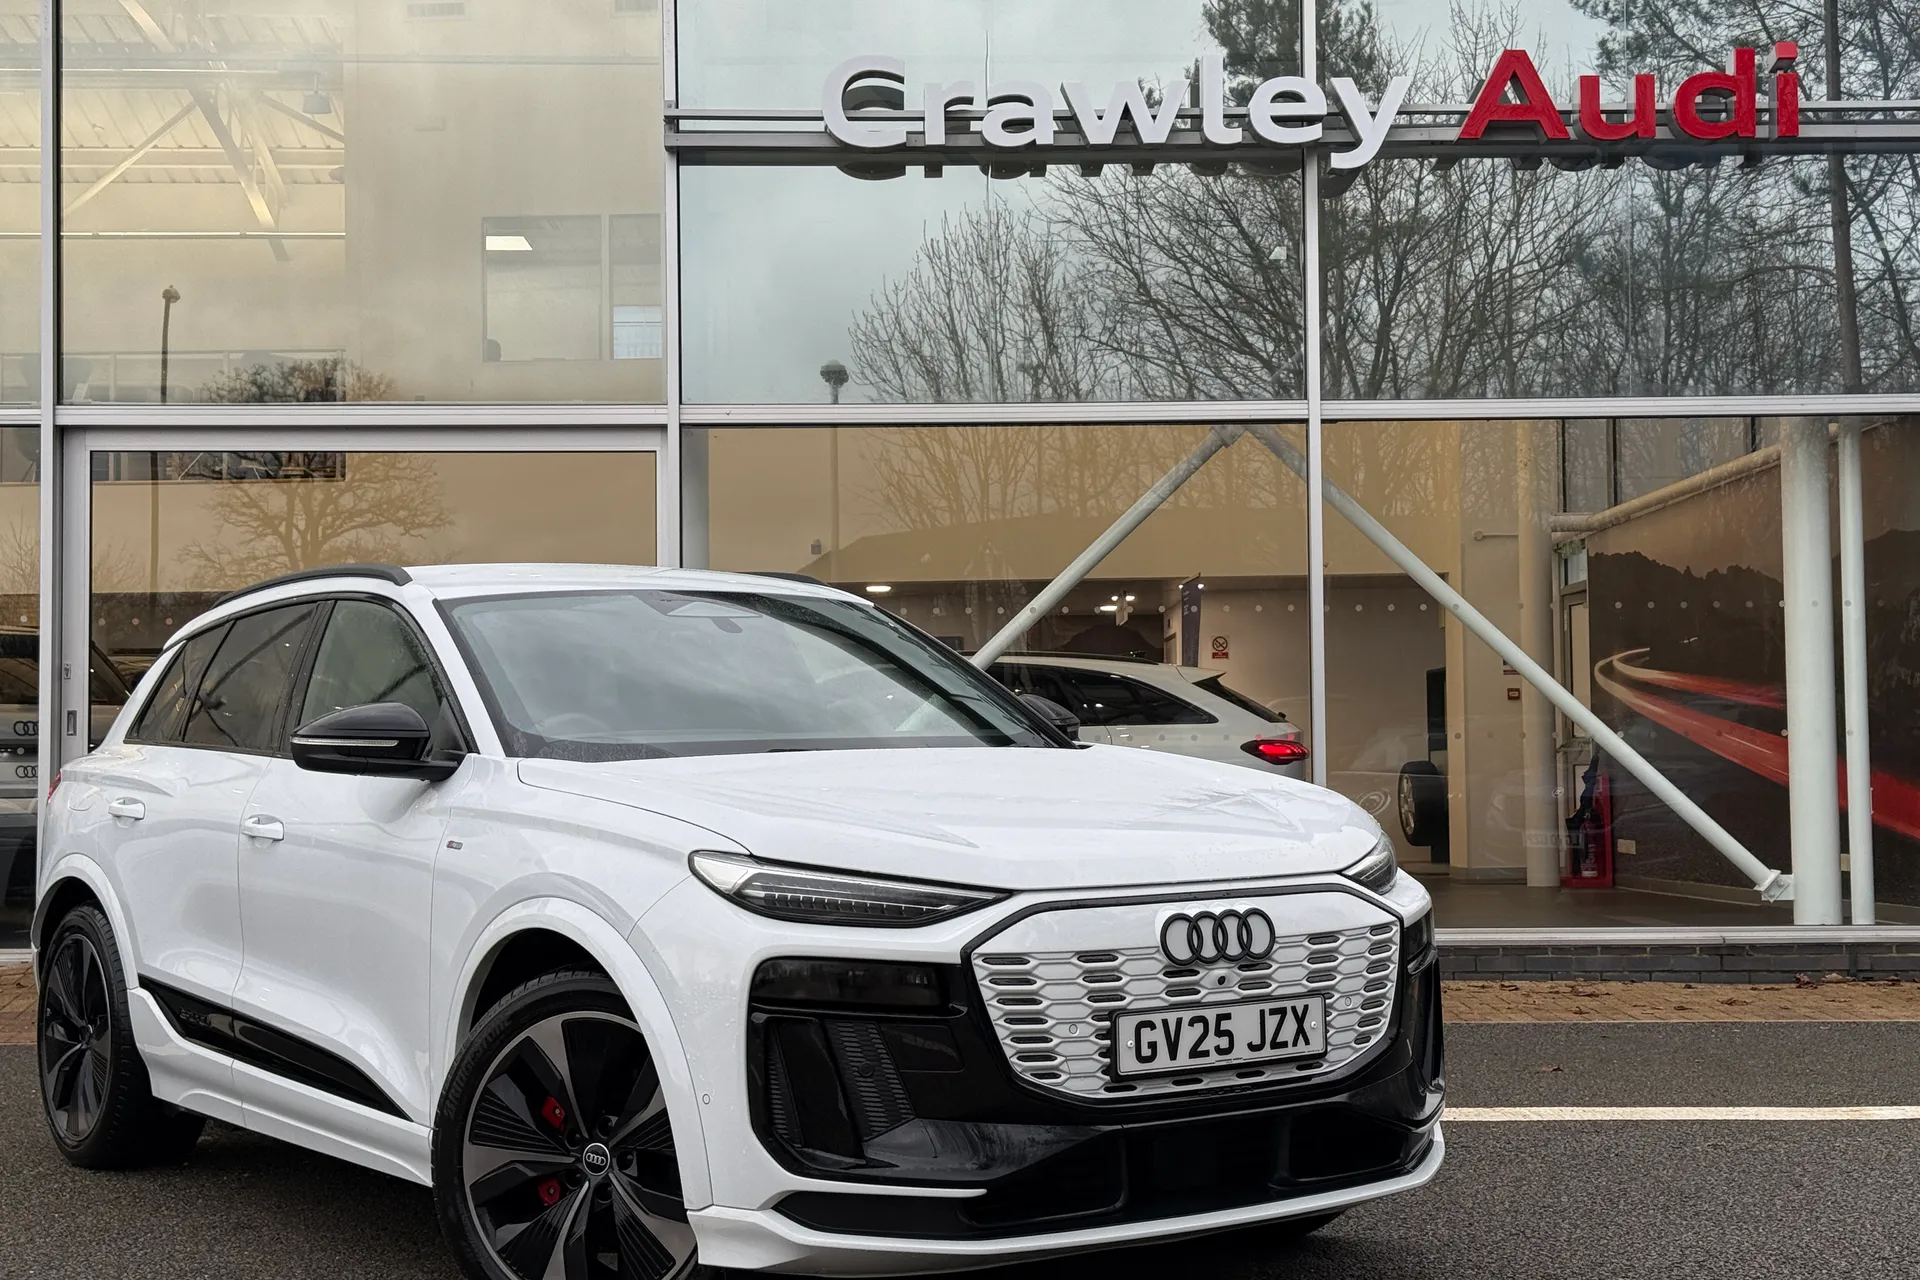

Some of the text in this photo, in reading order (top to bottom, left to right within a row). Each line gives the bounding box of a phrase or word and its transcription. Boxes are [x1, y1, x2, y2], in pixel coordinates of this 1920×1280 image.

[821, 42, 1800, 170] Crawley Audi
[1134, 1003, 1311, 1065] GV25 JZX
